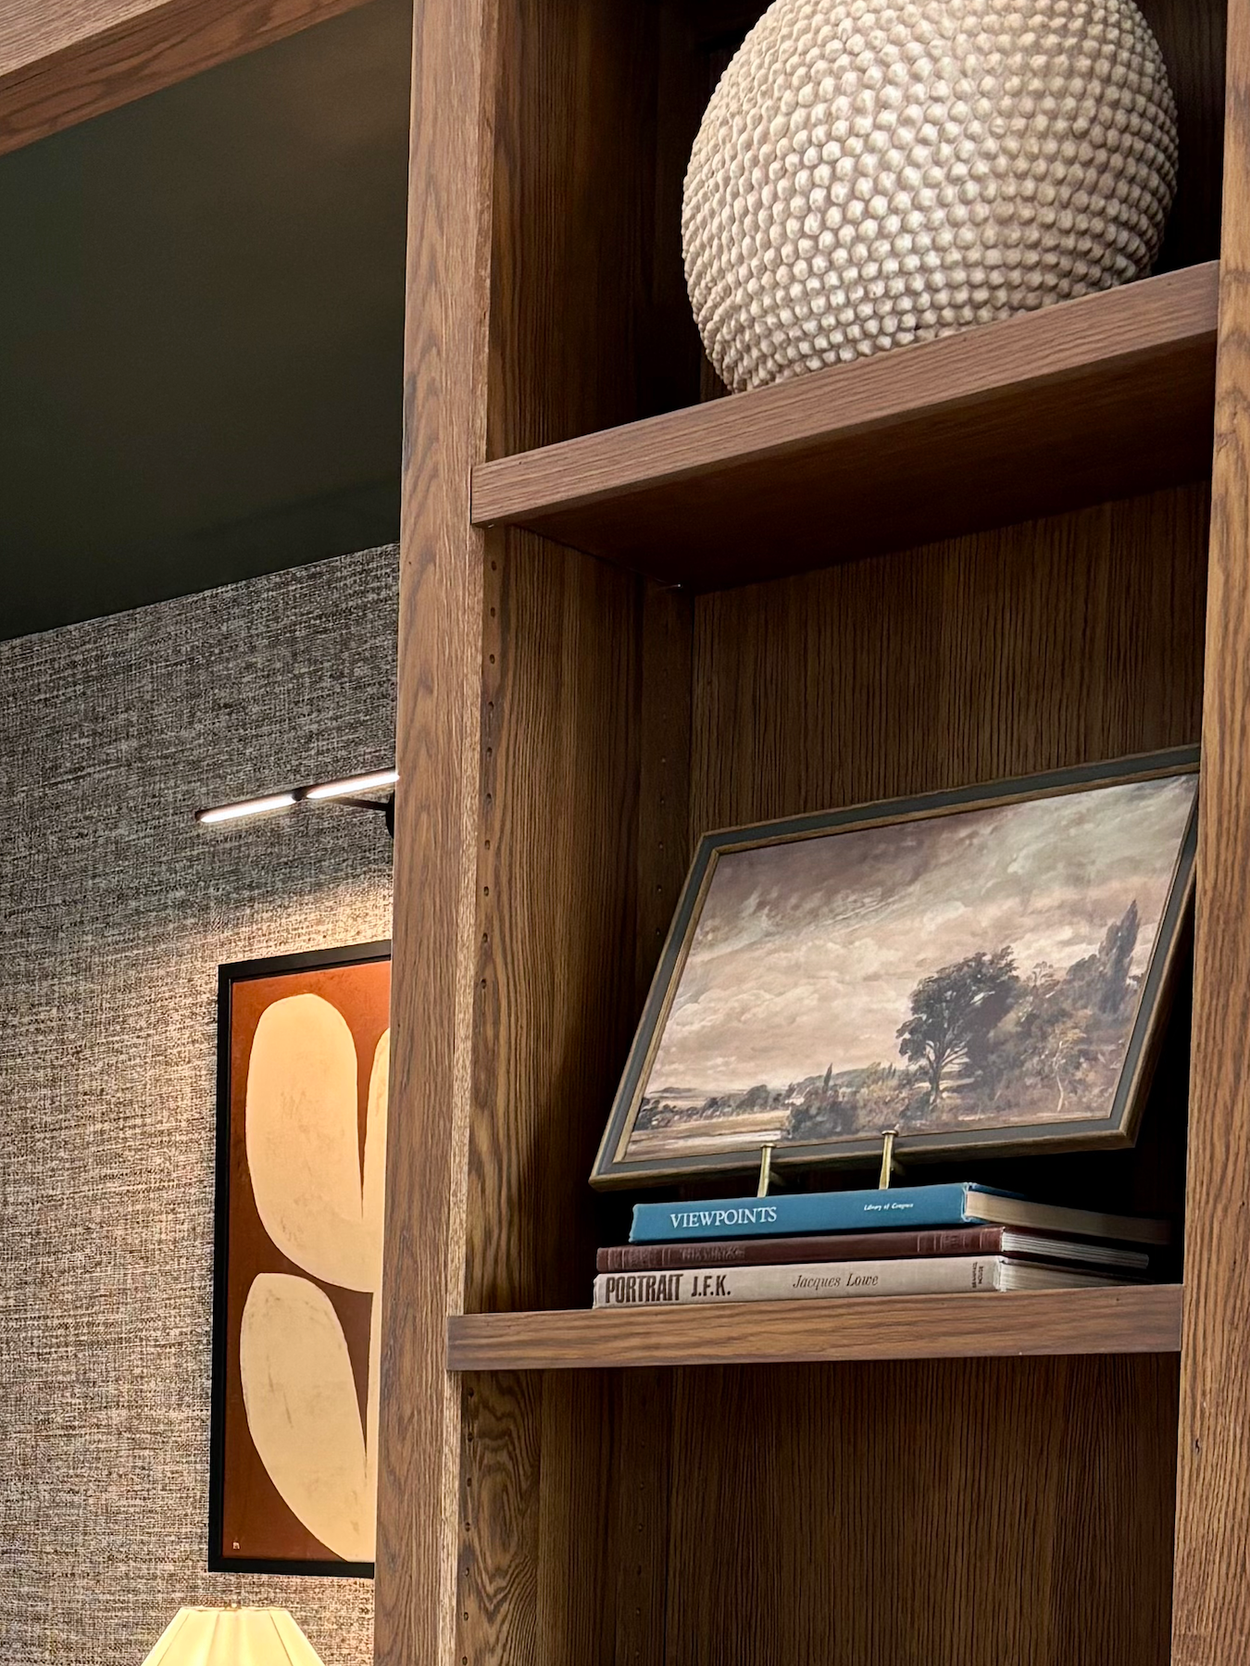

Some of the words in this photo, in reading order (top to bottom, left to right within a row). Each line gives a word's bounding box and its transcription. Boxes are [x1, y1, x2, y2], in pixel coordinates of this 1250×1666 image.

[670, 1206, 777, 1228] VIEWPOINTS
[605, 1273, 684, 1304] PORTRAIT
[691, 1274, 731, 1297] J.F.K.
[792, 1274, 841, 1291] Jacques
[846, 1272, 879, 1287] Lowe
